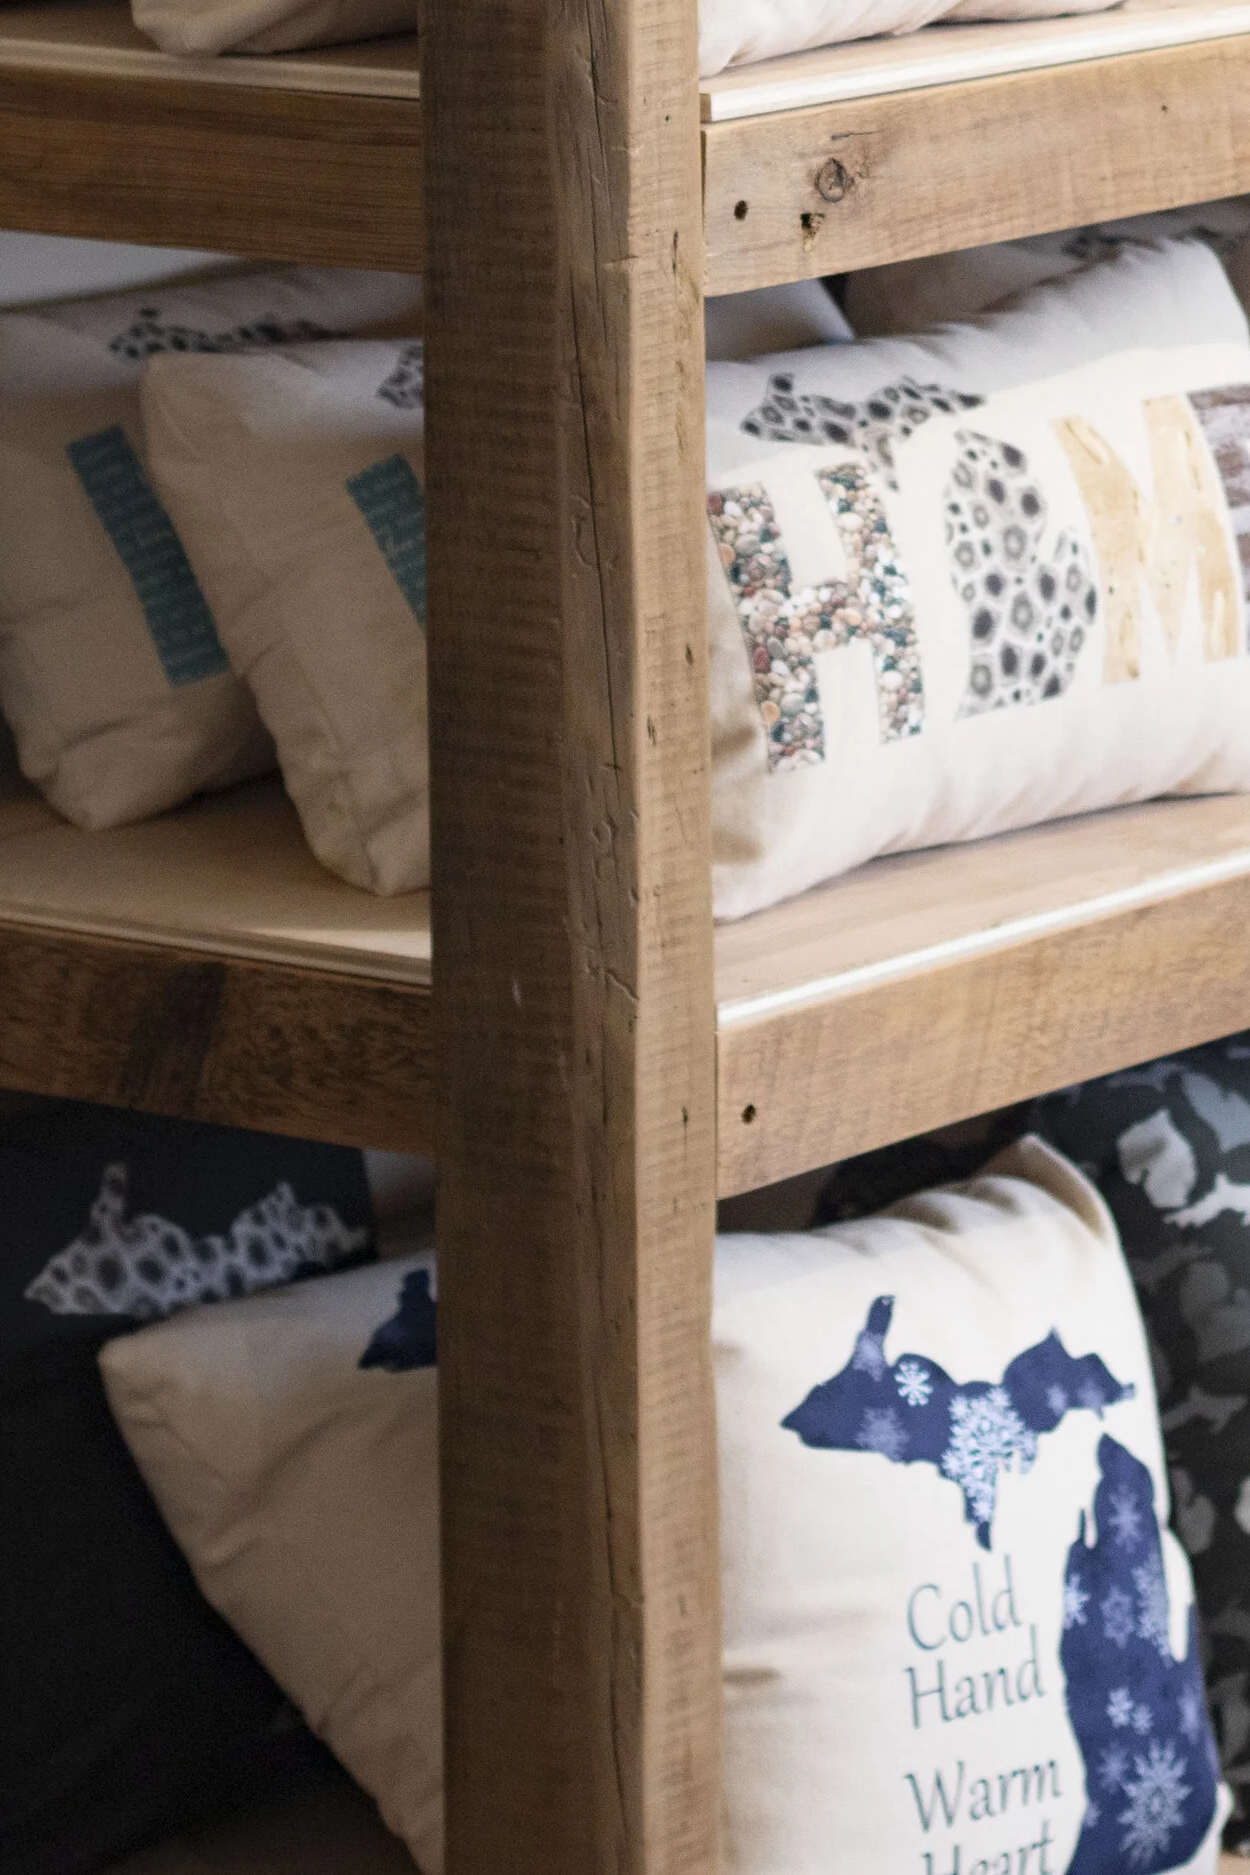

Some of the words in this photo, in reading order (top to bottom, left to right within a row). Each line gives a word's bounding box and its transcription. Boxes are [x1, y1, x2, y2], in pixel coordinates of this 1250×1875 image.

[906, 1554, 1022, 1651] Cold
[903, 1623, 1047, 1730] Hand
[904, 1759, 1063, 1834] Warm
